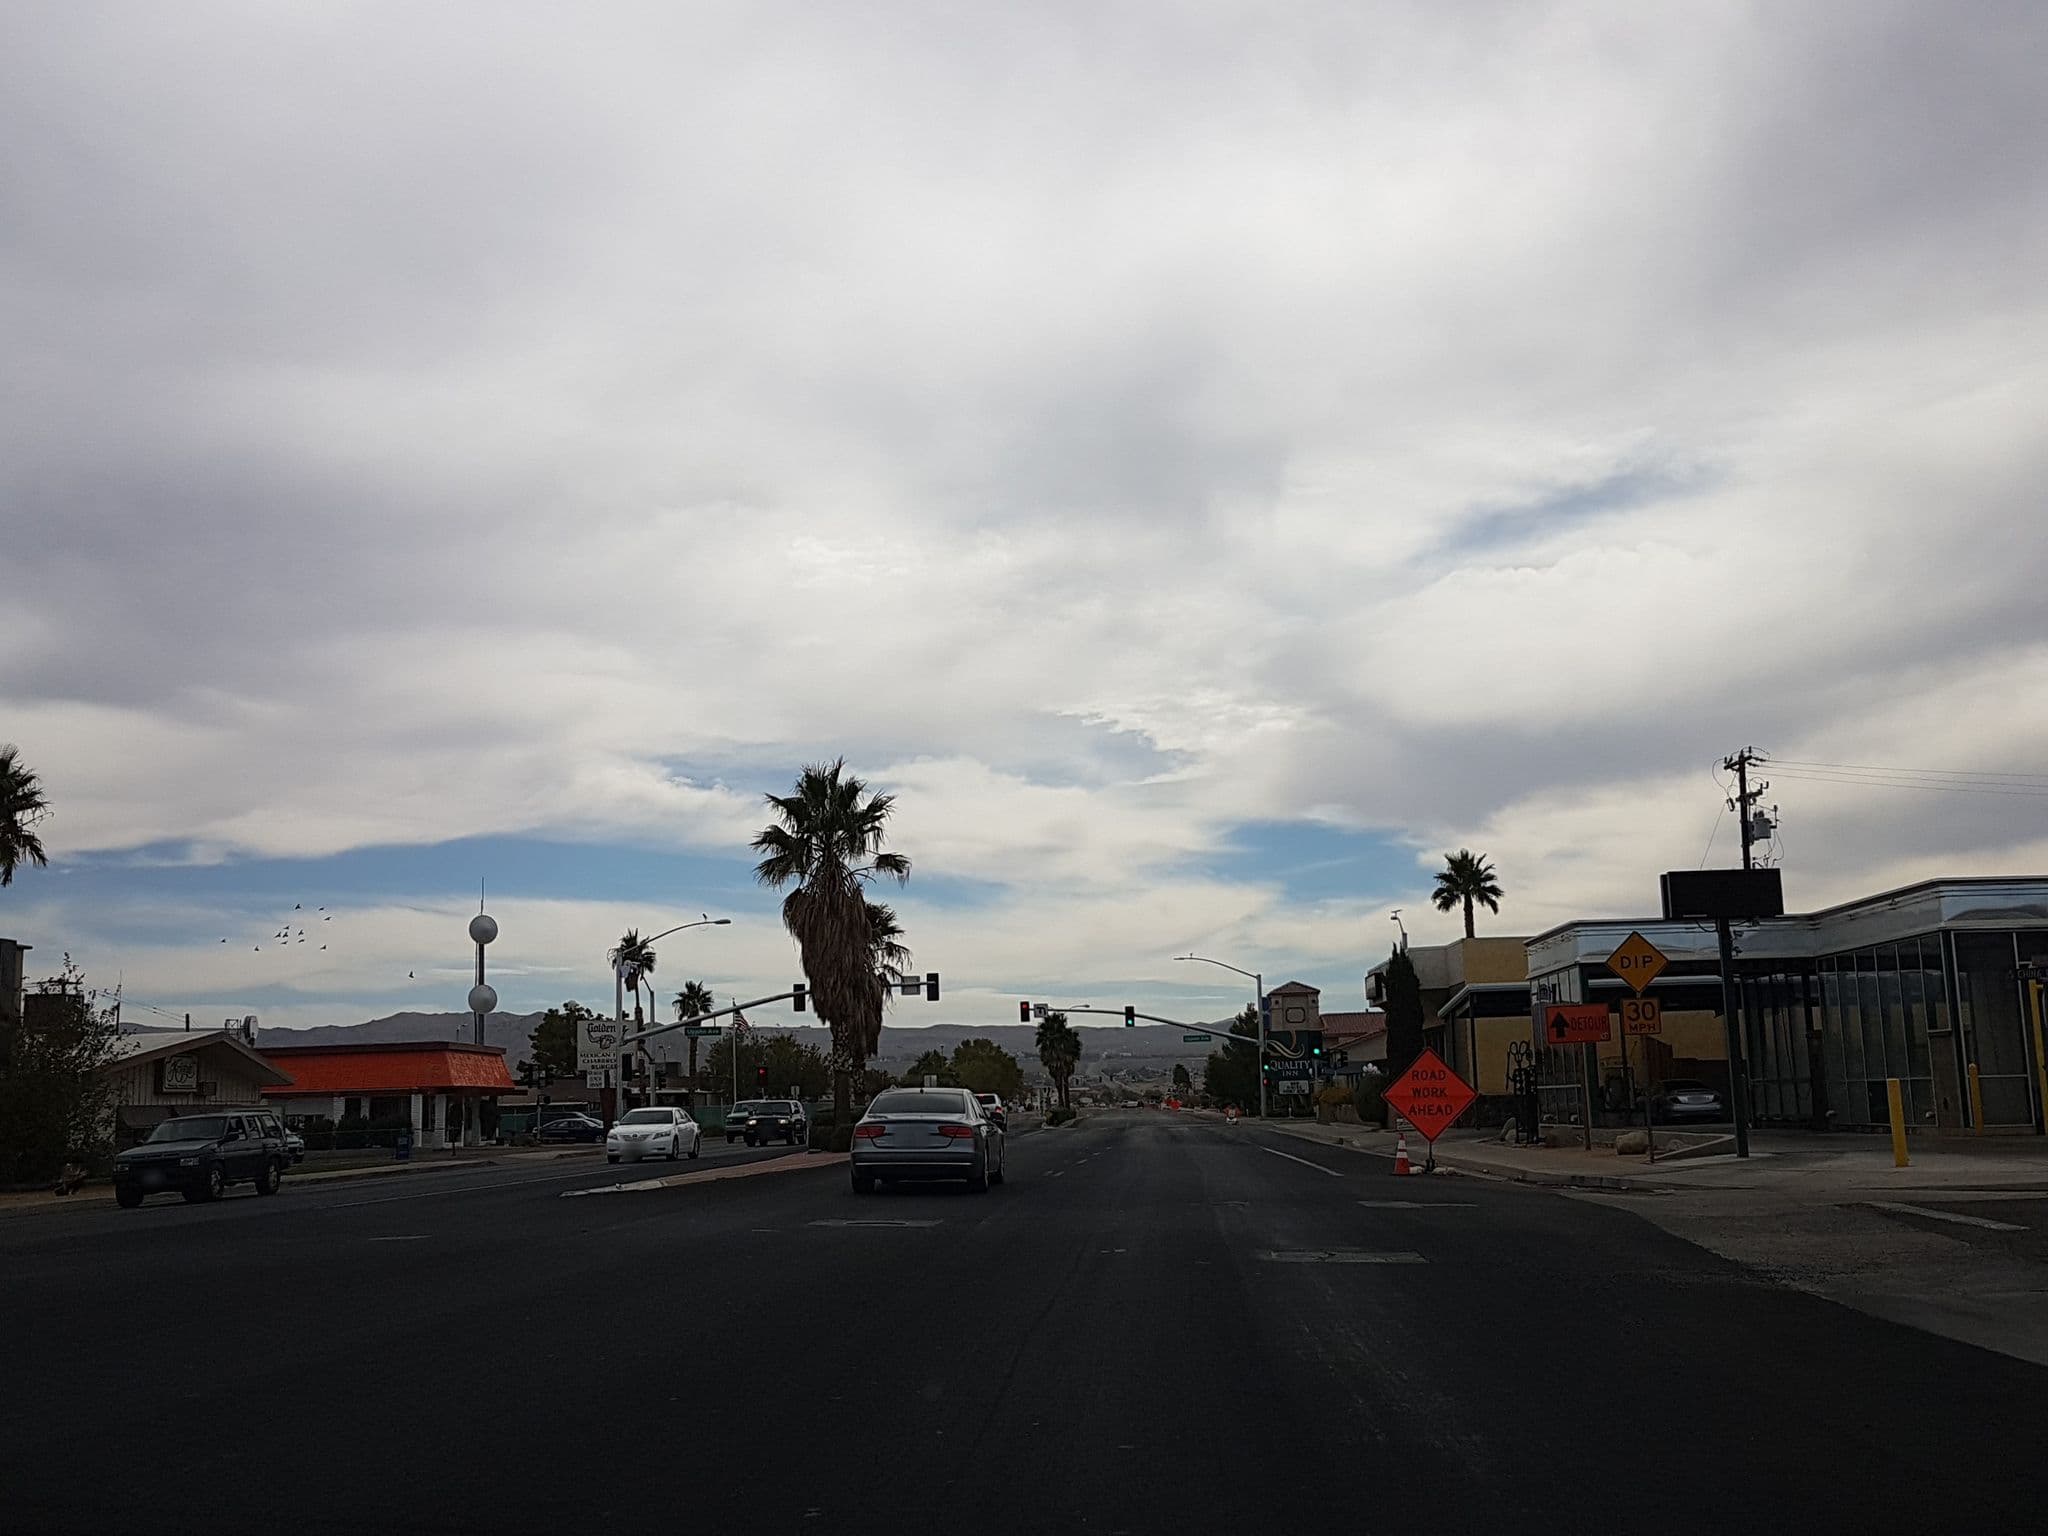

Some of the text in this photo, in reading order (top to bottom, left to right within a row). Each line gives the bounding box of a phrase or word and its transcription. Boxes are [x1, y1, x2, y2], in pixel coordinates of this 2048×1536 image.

[1620, 955, 1653, 969] DIP
[1627, 1001, 1656, 1021] 30
[588, 1022, 616, 1033] Golden
[1570, 1015, 1607, 1031] DETOUR
[1629, 1023, 1656, 1032] MPH
[1270, 1059, 1311, 1071] QUALITY
[1411, 1070, 1446, 1081] ROAD
[1412, 1087, 1448, 1098] WORK
[1408, 1103, 1453, 1116] AHEAD
